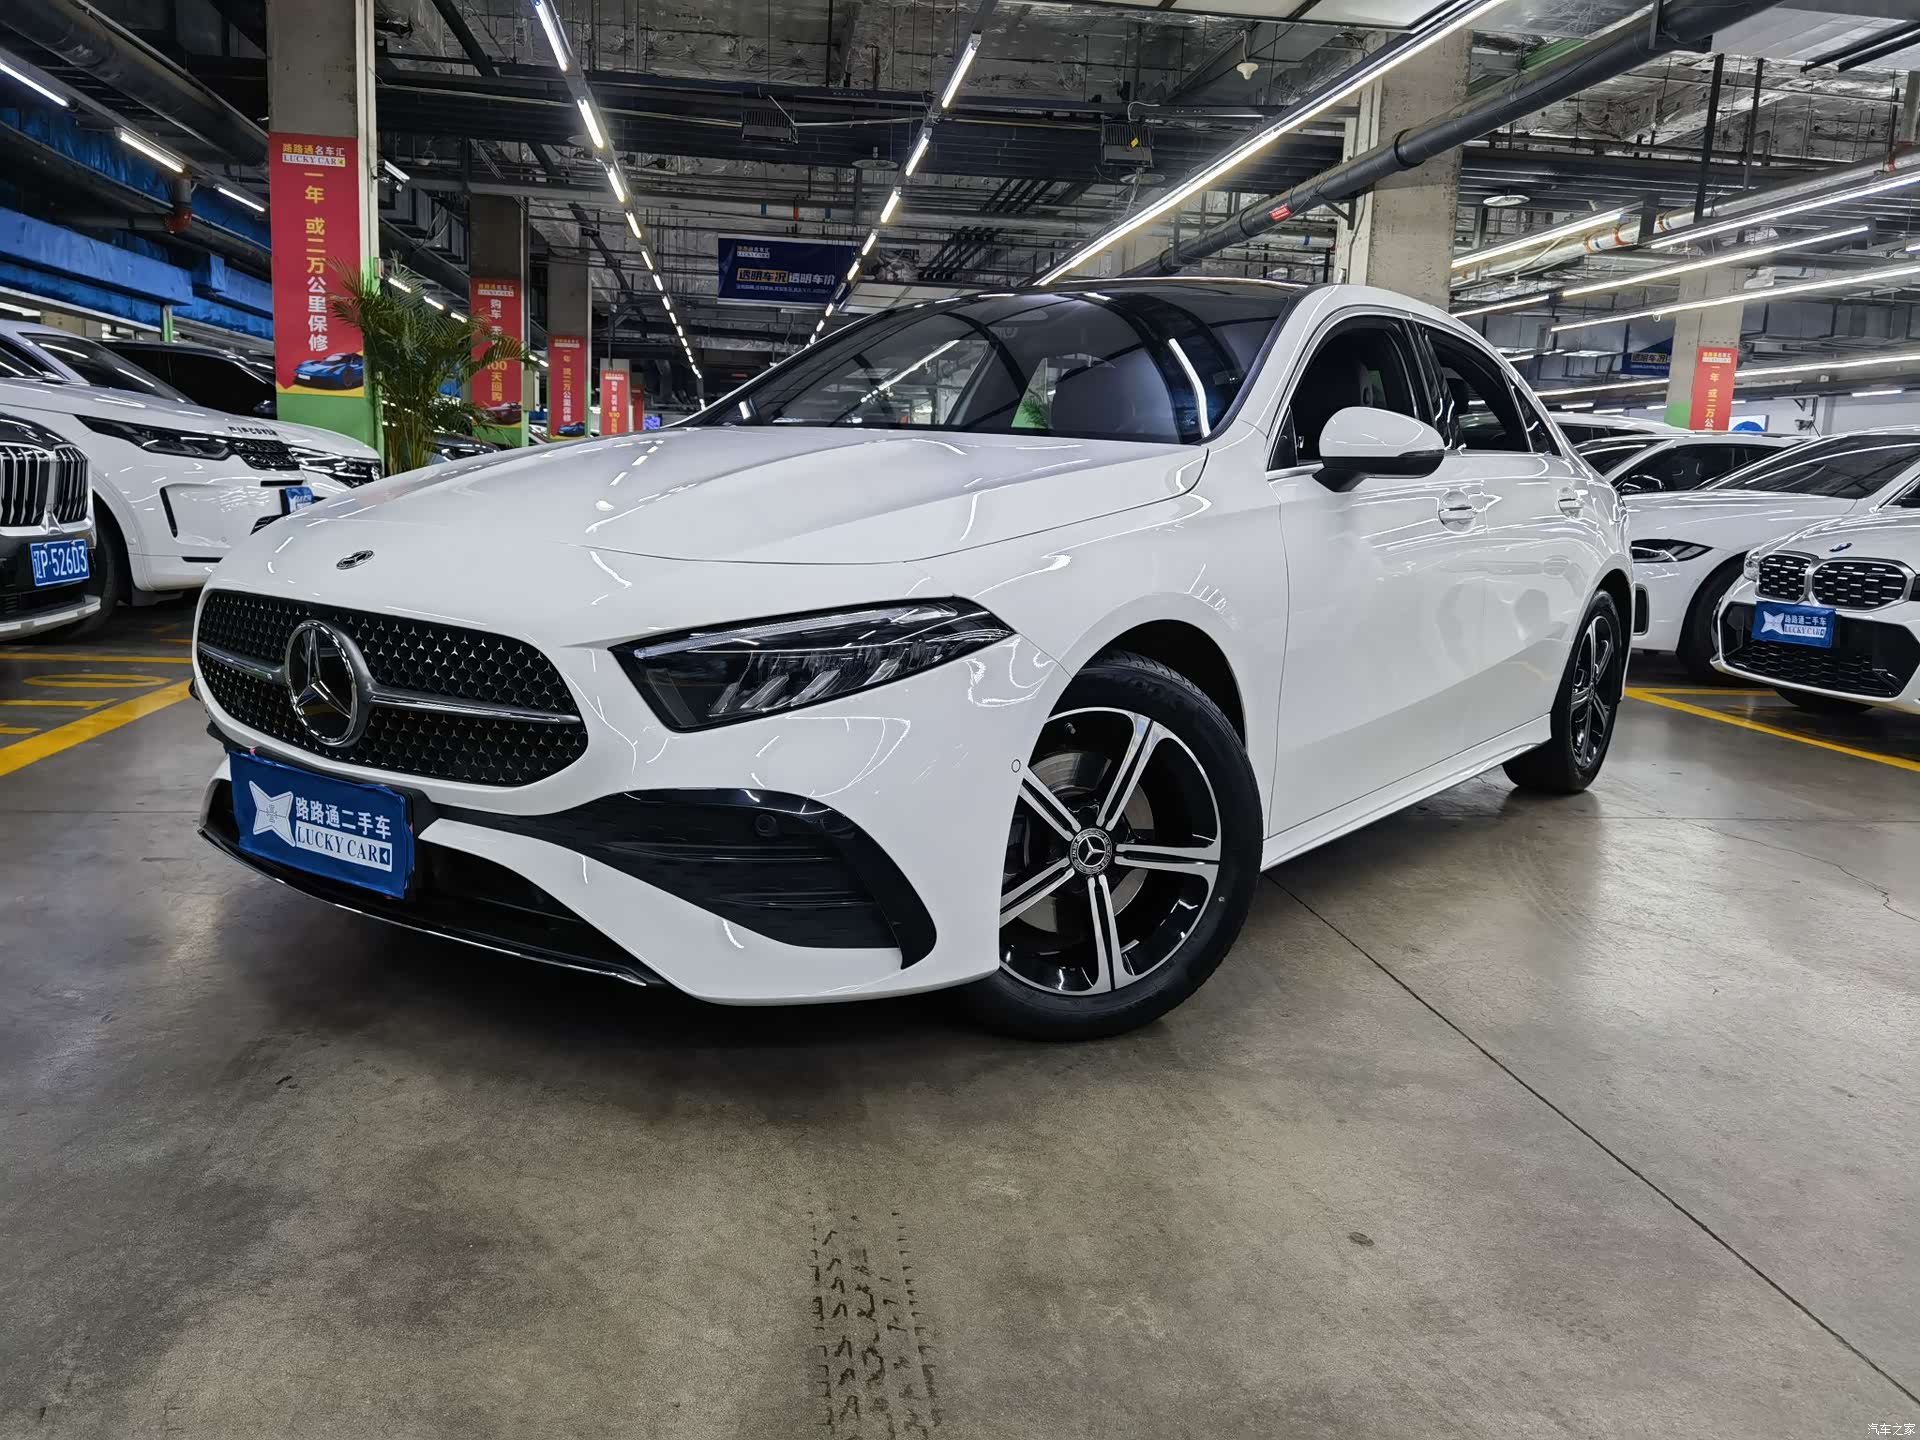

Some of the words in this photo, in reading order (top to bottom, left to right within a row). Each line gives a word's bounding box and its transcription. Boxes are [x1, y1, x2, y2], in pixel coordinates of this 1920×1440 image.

[283, 143, 345, 157] 路路通名车汇
[284, 154, 315, 164] LUCKY
[318, 157, 337, 166] CAR
[304, 171, 325, 203] 一年
[305, 217, 329, 352] 或二万公里保修
[739, 271, 787, 283] 透明车况
[788, 272, 835, 285] 透明车价
[1704, 389, 1718, 430] 或二万公
[1784, 613, 1827, 626] 路路通二手车
[295, 796, 392, 840] 路路通二手车
[296, 825, 344, 855] LUCKY
[346, 839, 380, 864] CAR
